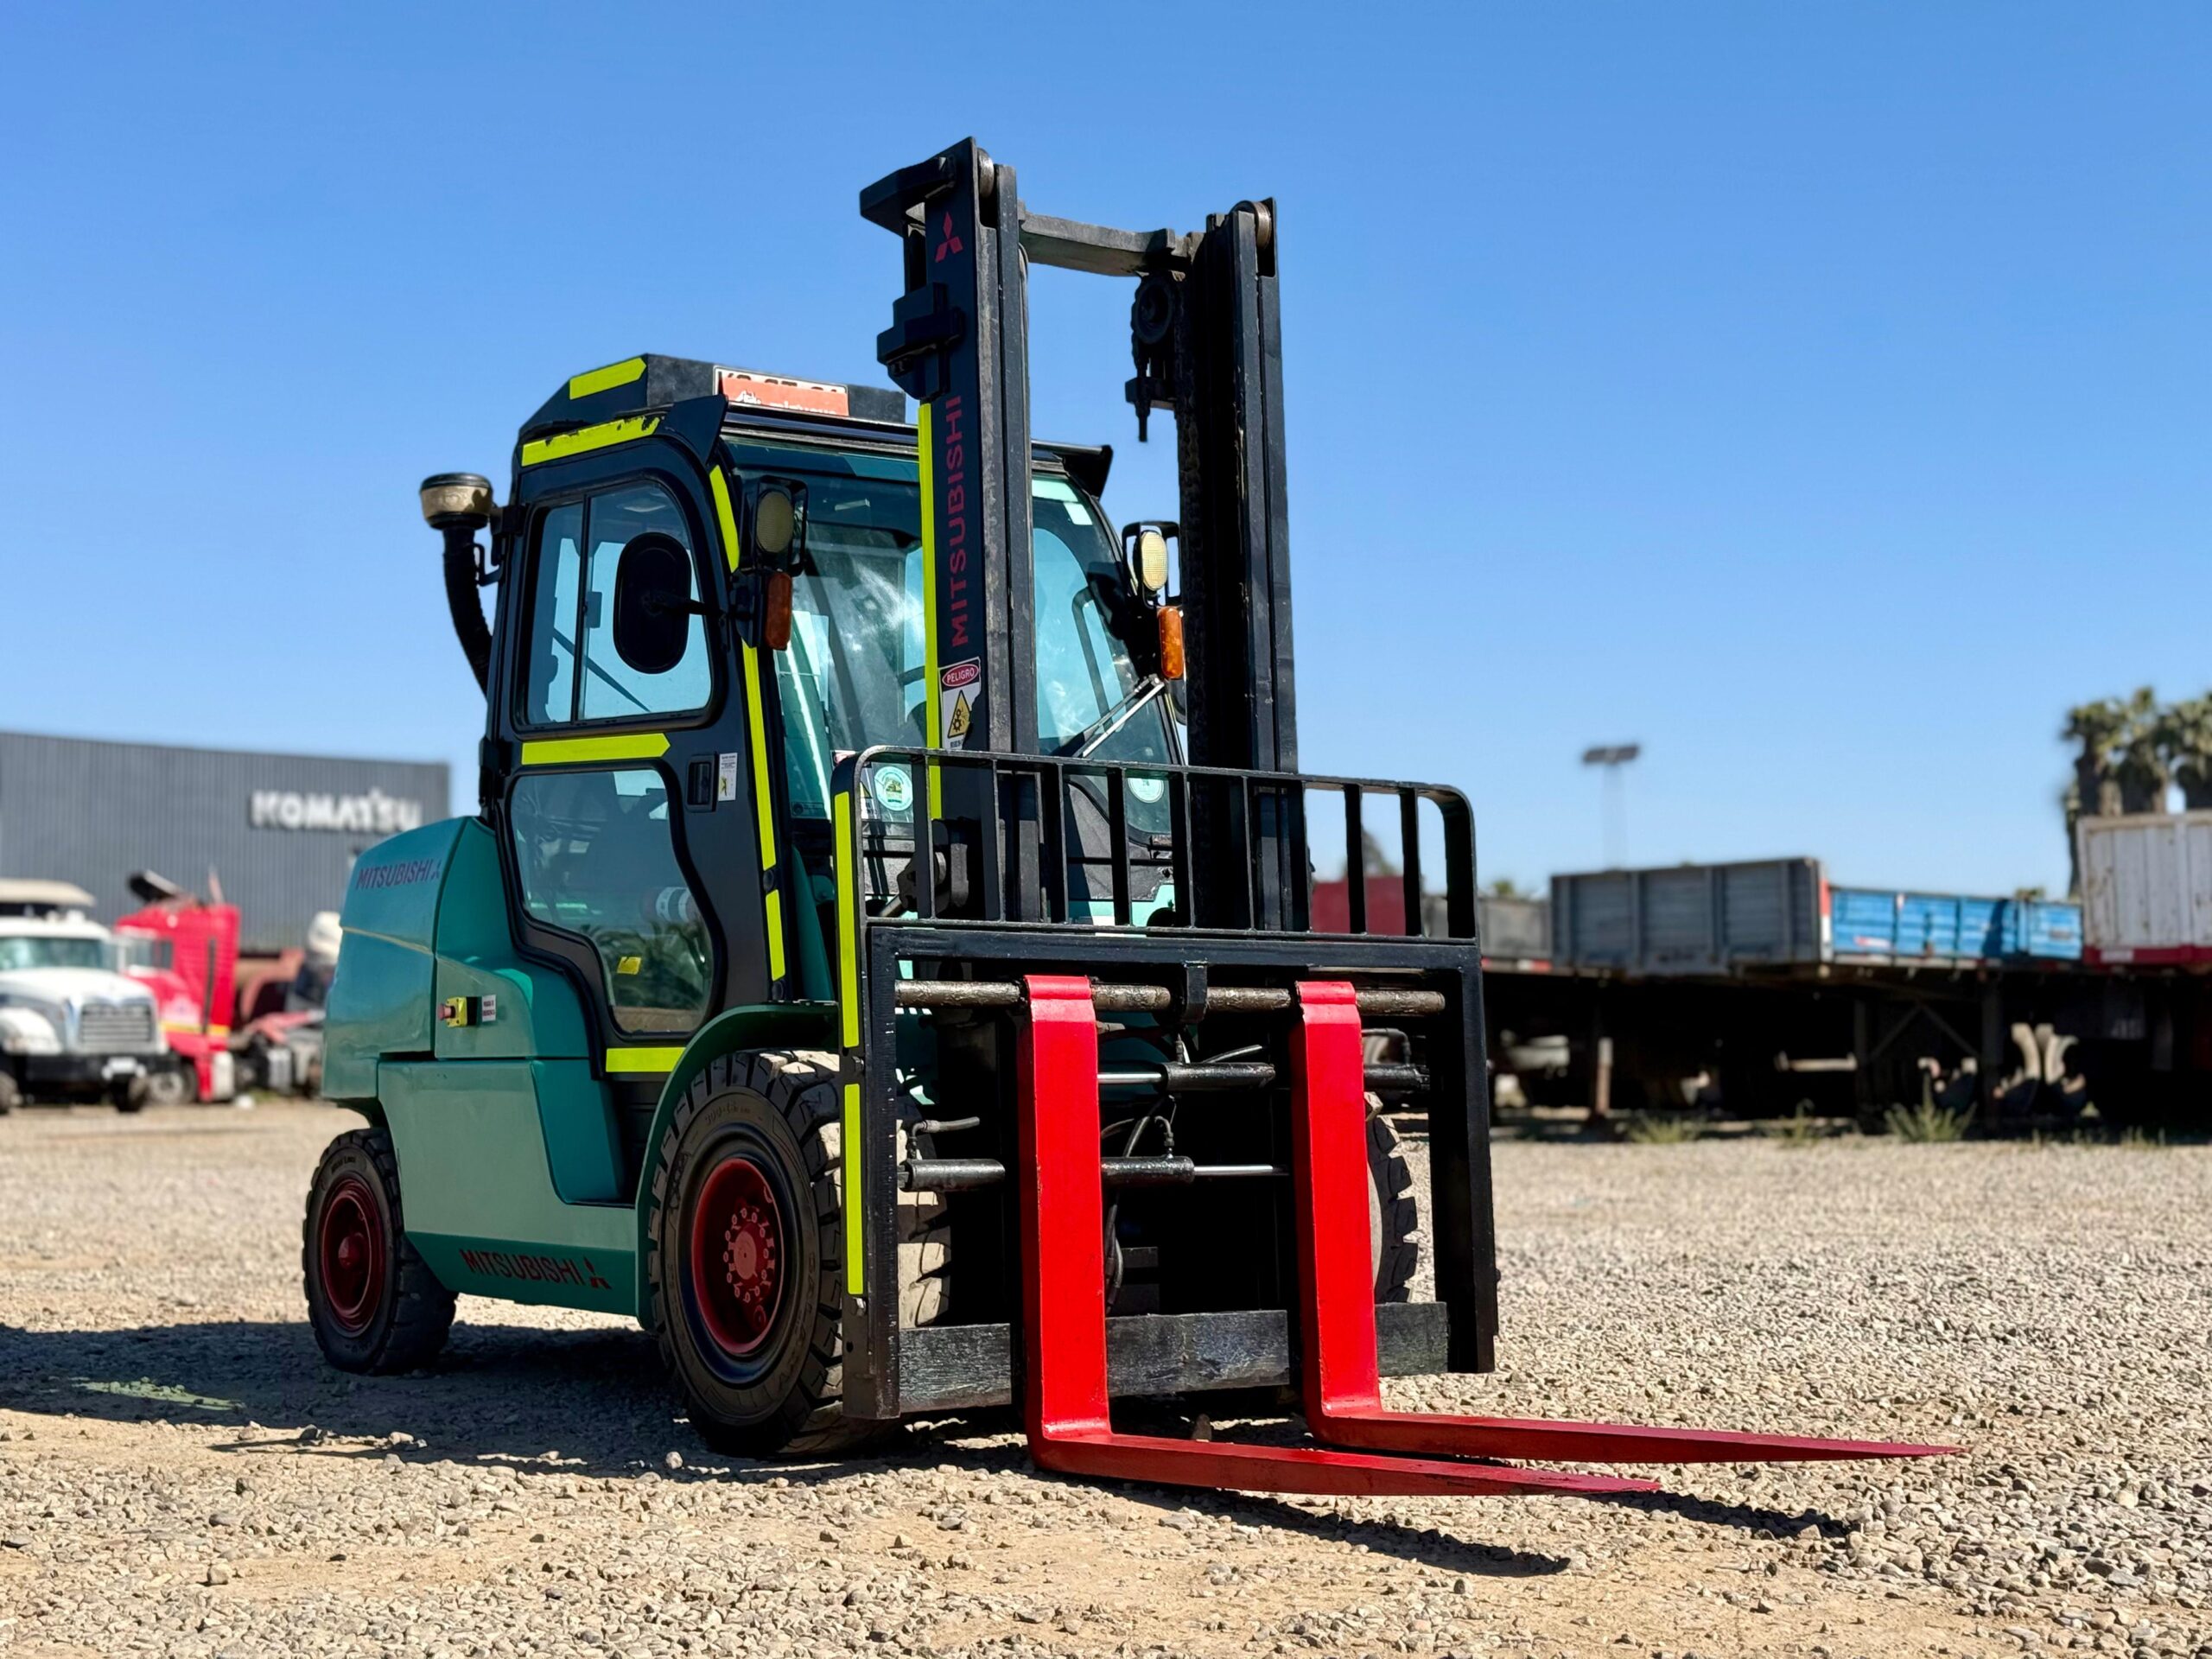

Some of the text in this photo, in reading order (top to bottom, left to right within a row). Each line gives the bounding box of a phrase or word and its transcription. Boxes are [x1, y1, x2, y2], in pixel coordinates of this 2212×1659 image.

[946, 395, 969, 646] MITSUBISHI
[946, 667, 976, 683] PELIGRO
[251, 788, 422, 831] KOMATSU
[355, 859, 433, 890] MITSUBISHI
[459, 1249, 586, 1286] MITSUBISHI
